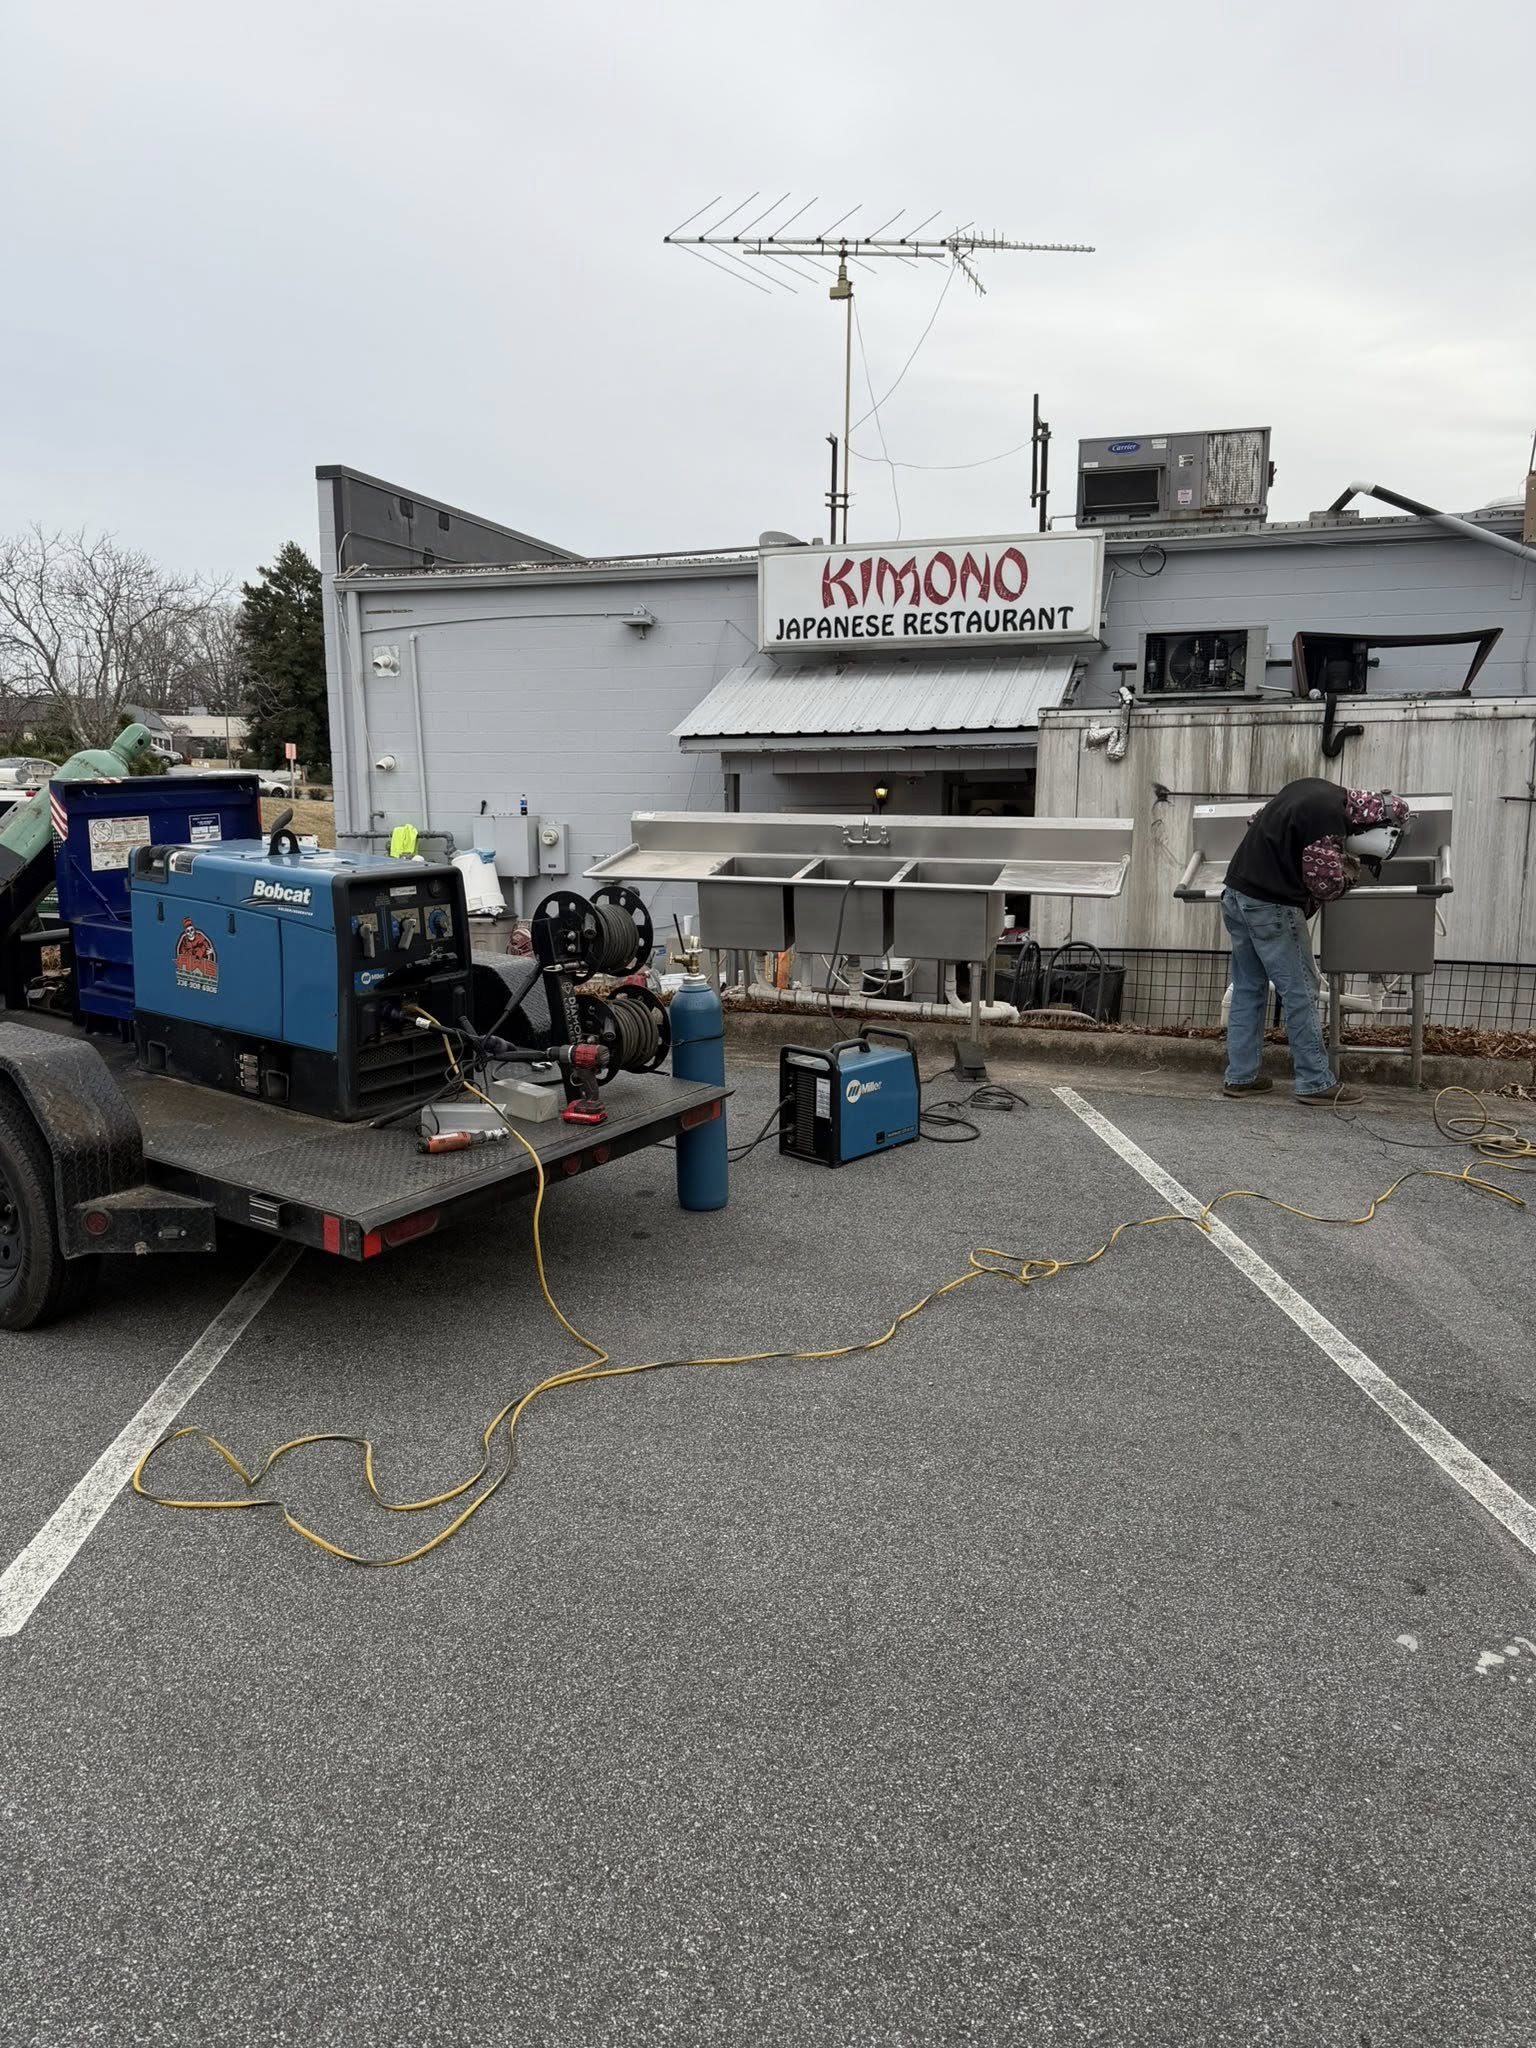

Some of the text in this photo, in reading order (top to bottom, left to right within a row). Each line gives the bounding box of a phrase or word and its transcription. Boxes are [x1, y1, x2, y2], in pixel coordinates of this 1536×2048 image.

[1112, 444, 1137, 452] Carrier
[821, 547, 1029, 610] KIMONO
[776, 605, 1075, 640] JAPANESE RESTAURANT
[253, 879, 312, 905] Bobcat
[861, 1081, 882, 1094] Miller
